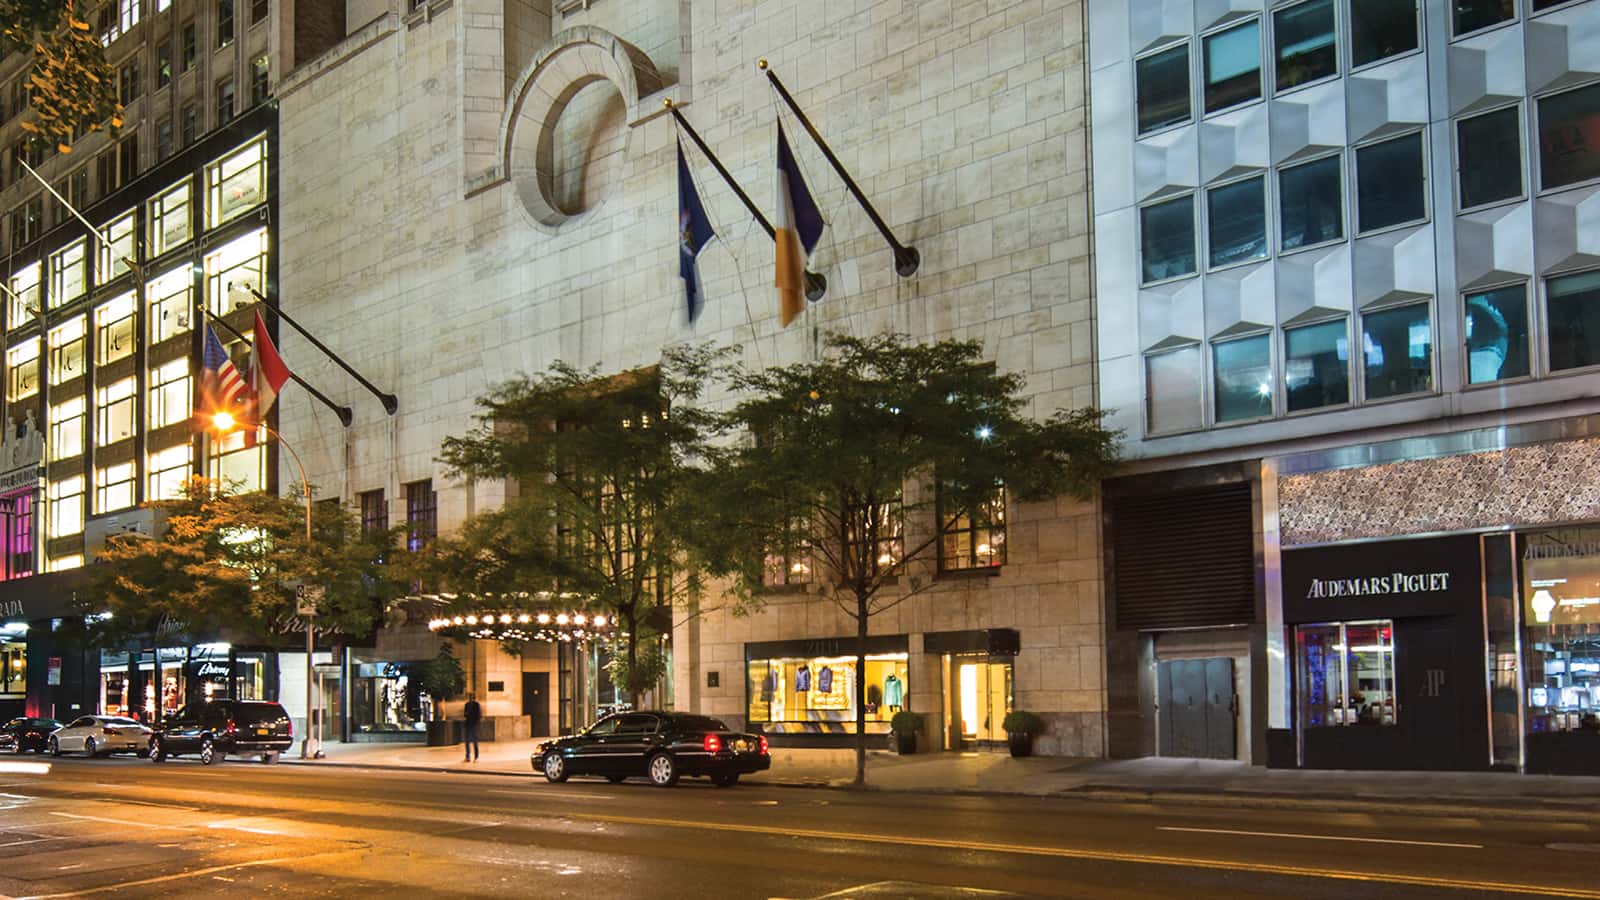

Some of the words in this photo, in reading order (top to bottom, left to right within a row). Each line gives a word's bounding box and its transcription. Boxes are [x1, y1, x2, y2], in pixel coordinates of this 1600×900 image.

[1306, 578, 1391, 599] AUDEMARS
[1391, 572, 1450, 593] PIGUET
[1418, 669, 1445, 697] AP
